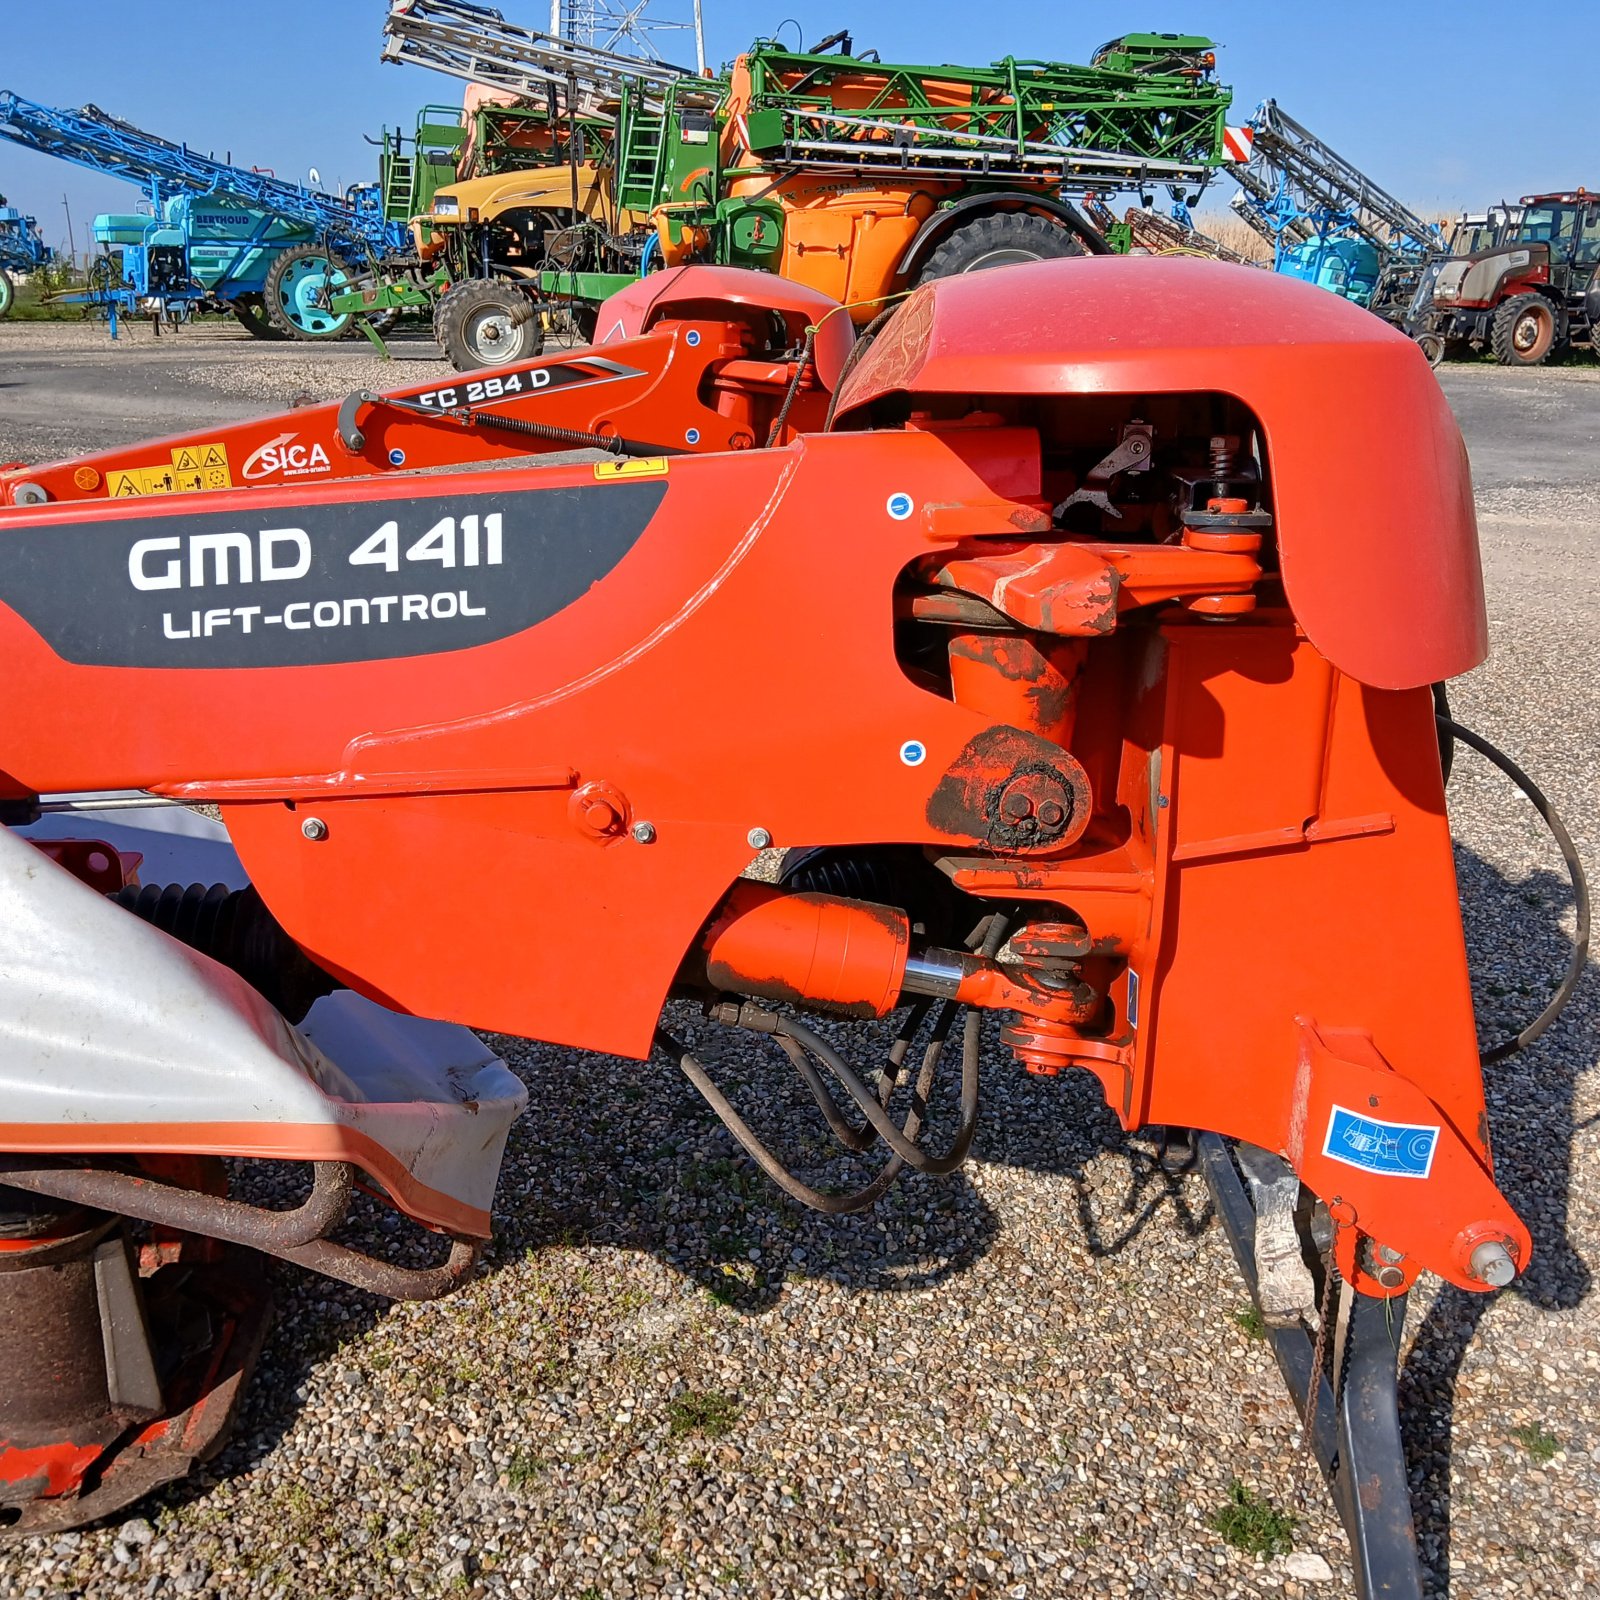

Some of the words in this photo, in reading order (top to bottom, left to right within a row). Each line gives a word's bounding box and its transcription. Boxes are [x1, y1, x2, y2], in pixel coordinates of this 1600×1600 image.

[196, 215, 249, 225] BERTHOUD
[466, 374, 522, 402] 284
[530, 368, 551, 388] D
[260, 443, 331, 472] SICA
[128, 528, 312, 591] GMD
[349, 513, 503, 573] 4411
[163, 591, 486, 640] LIFT-CONTROL
